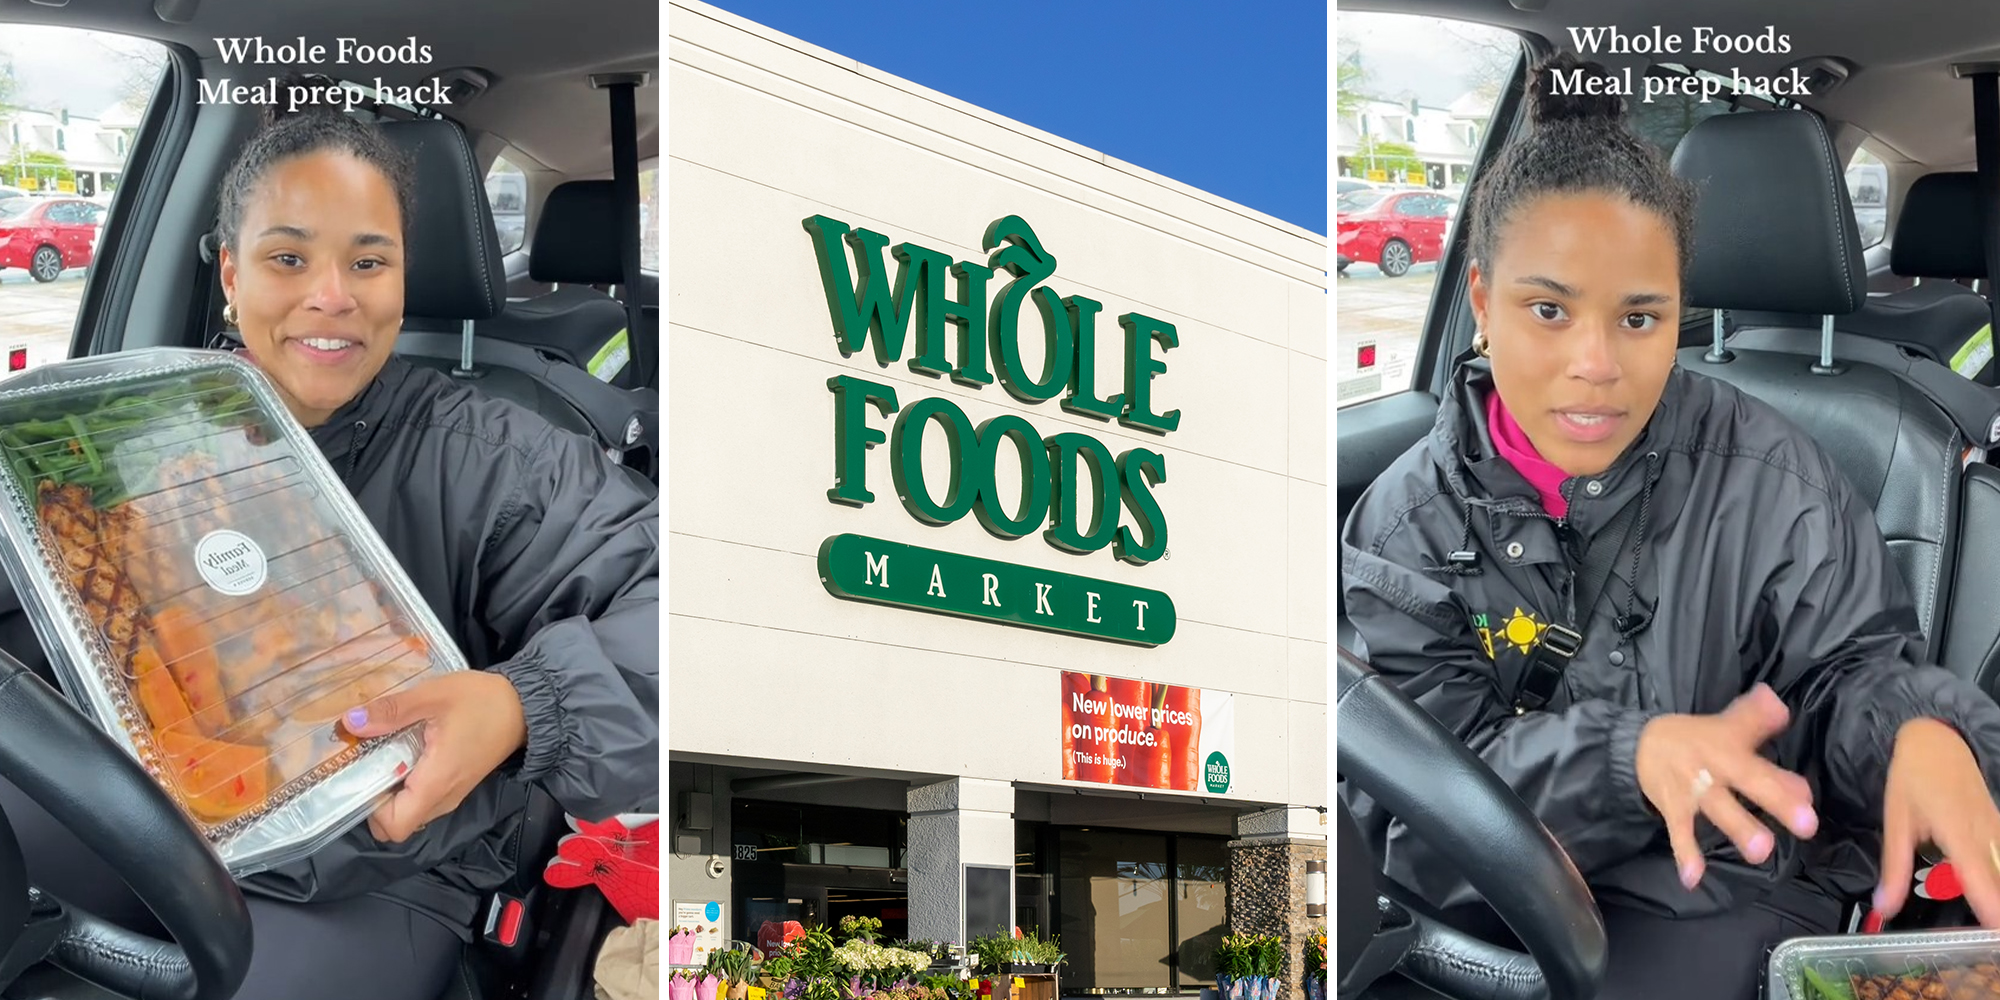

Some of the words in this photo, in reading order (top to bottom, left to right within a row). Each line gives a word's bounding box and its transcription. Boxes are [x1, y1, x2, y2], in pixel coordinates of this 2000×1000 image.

[802, 214, 1181, 436] WHOLE
[826, 374, 1169, 566] FOODS
[864, 551, 1149, 631] MARKET
[1072, 691, 1107, 716] New
[1110, 696, 1148, 721] lower
[1151, 704, 1194, 727] prices
[1072, 723, 1092, 740] on
[1094, 724, 1158, 747] produce.
[1072, 750, 1093, 765] (This
[1094, 753, 1101, 765] is
[1102, 755, 1127, 769] huge.)
[1207, 760, 1228, 775] WHOLE
[1208, 773, 1228, 783] FOODS
[766, 939, 781, 948] New
